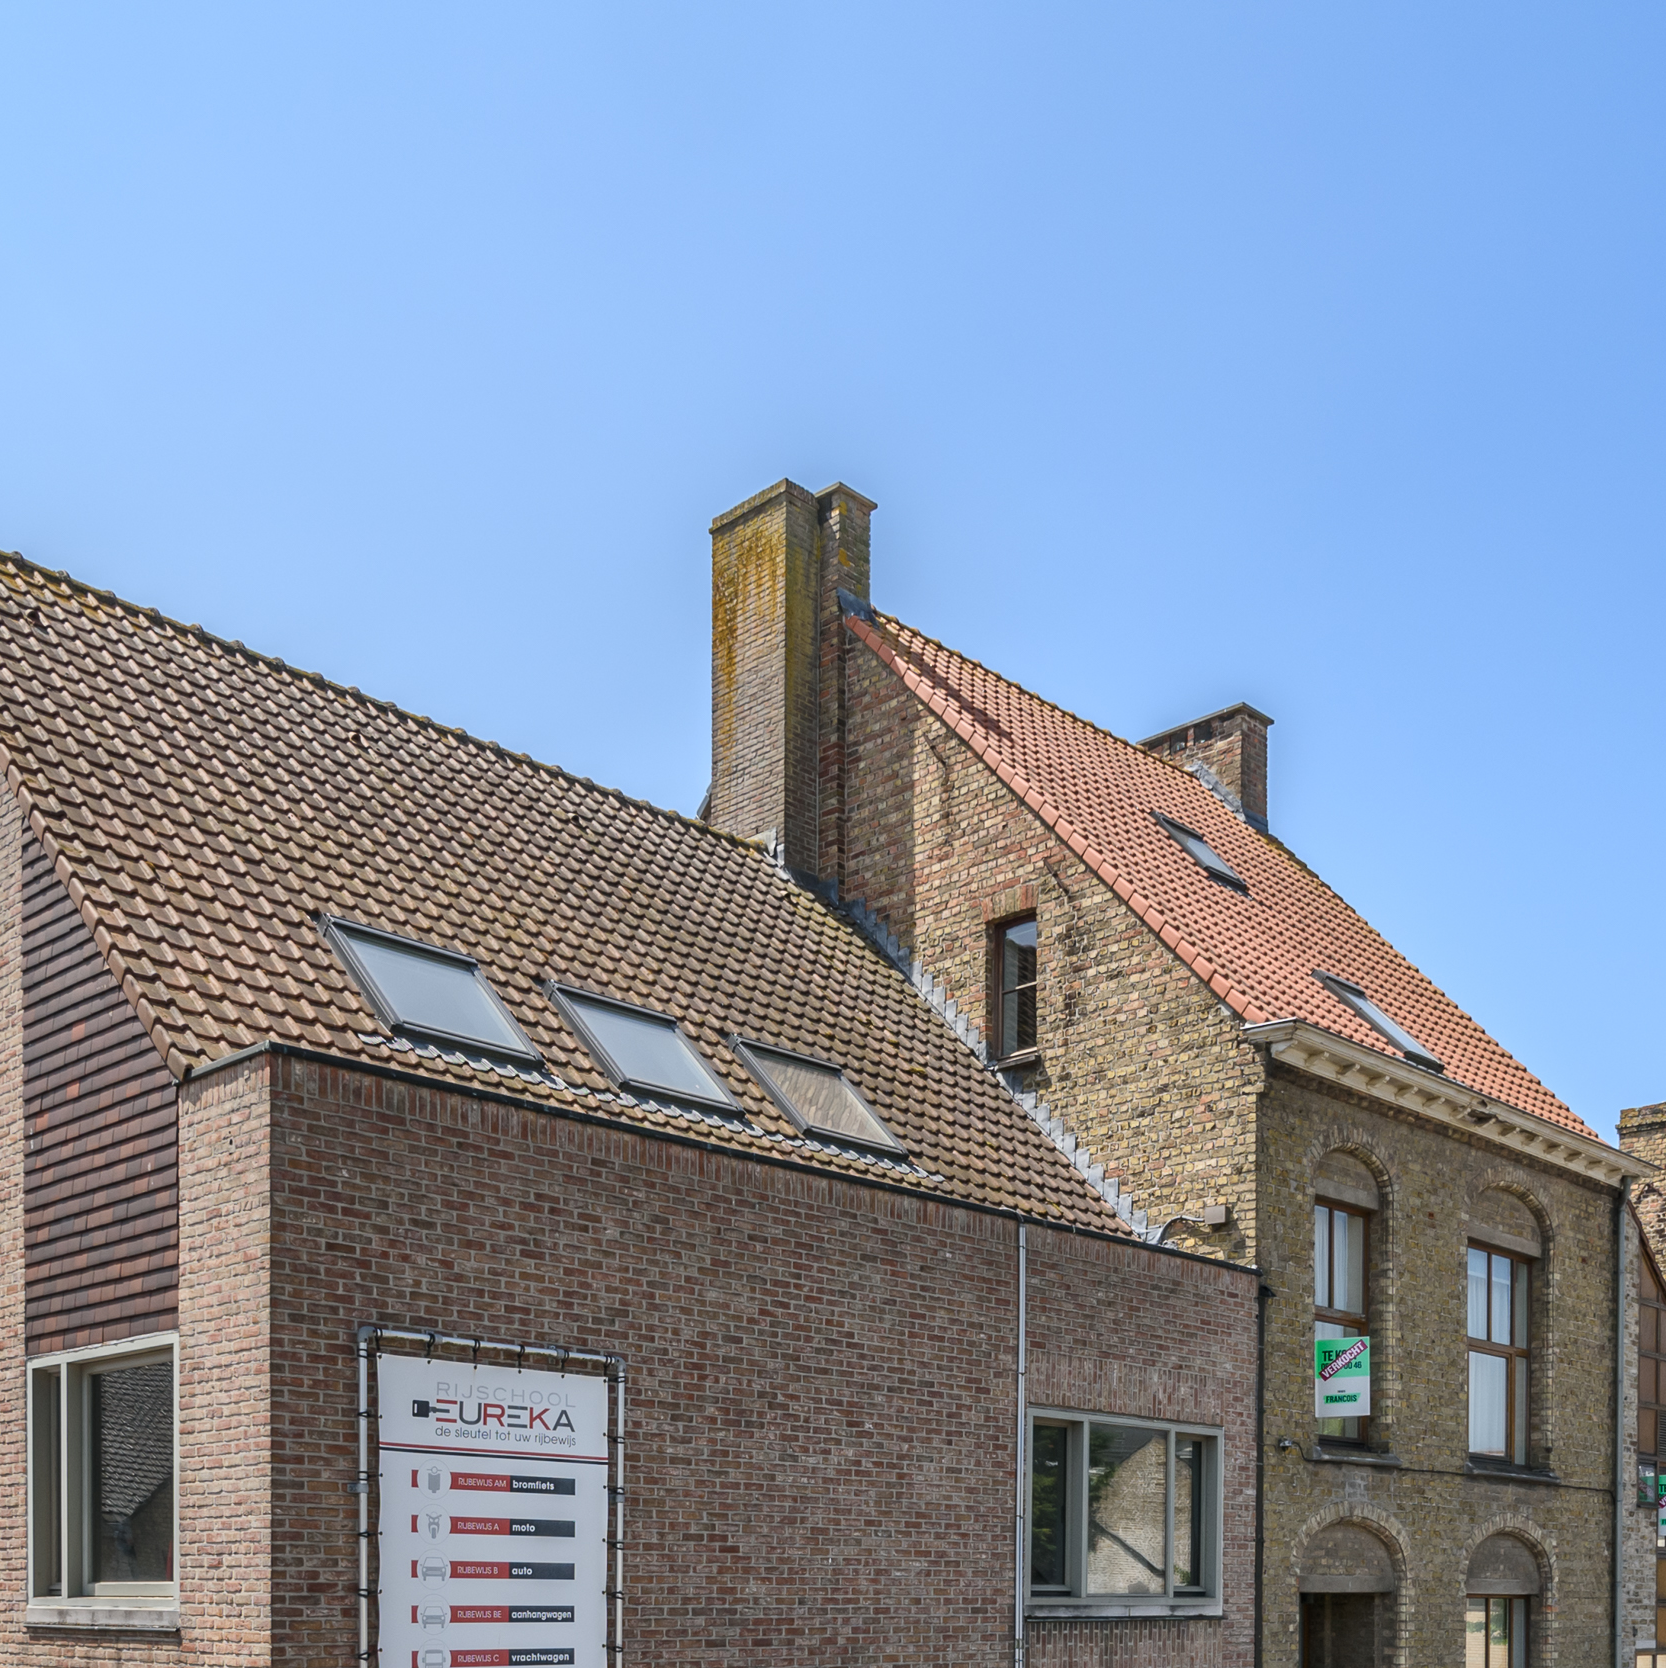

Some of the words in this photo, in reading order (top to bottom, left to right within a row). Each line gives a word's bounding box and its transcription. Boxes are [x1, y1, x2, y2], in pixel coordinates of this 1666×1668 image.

[1322, 1351, 1333, 1361] TE
[1322, 1342, 1364, 1377] VERKOCHT
[437, 1382, 576, 1408] RIJSCHOOL
[1326, 1395, 1357, 1403] FRANCOIS
[436, 1399, 575, 1432] EUREKA
[435, 1426, 451, 1436] de
[455, 1427, 491, 1439] sleutel
[496, 1431, 510, 1441] tot
[515, 1434, 531, 1442] uw
[535, 1433, 576, 1447] rijbewijs
[458, 1477, 493, 1486] RIJBEWIJS
[494, 1478, 506, 1487] AM
[513, 1480, 554, 1490] bromfiets
[458, 1522, 492, 1531] RIJBEWIJS
[512, 1524, 535, 1532] moto
[458, 1566, 492, 1574] RIJBEWIJS
[512, 1566, 532, 1575] auto
[512, 1610, 571, 1620] aanhangwagen
[493, 1654, 499, 1662] C
[512, 1653, 569, 1663] vrachtwagen
